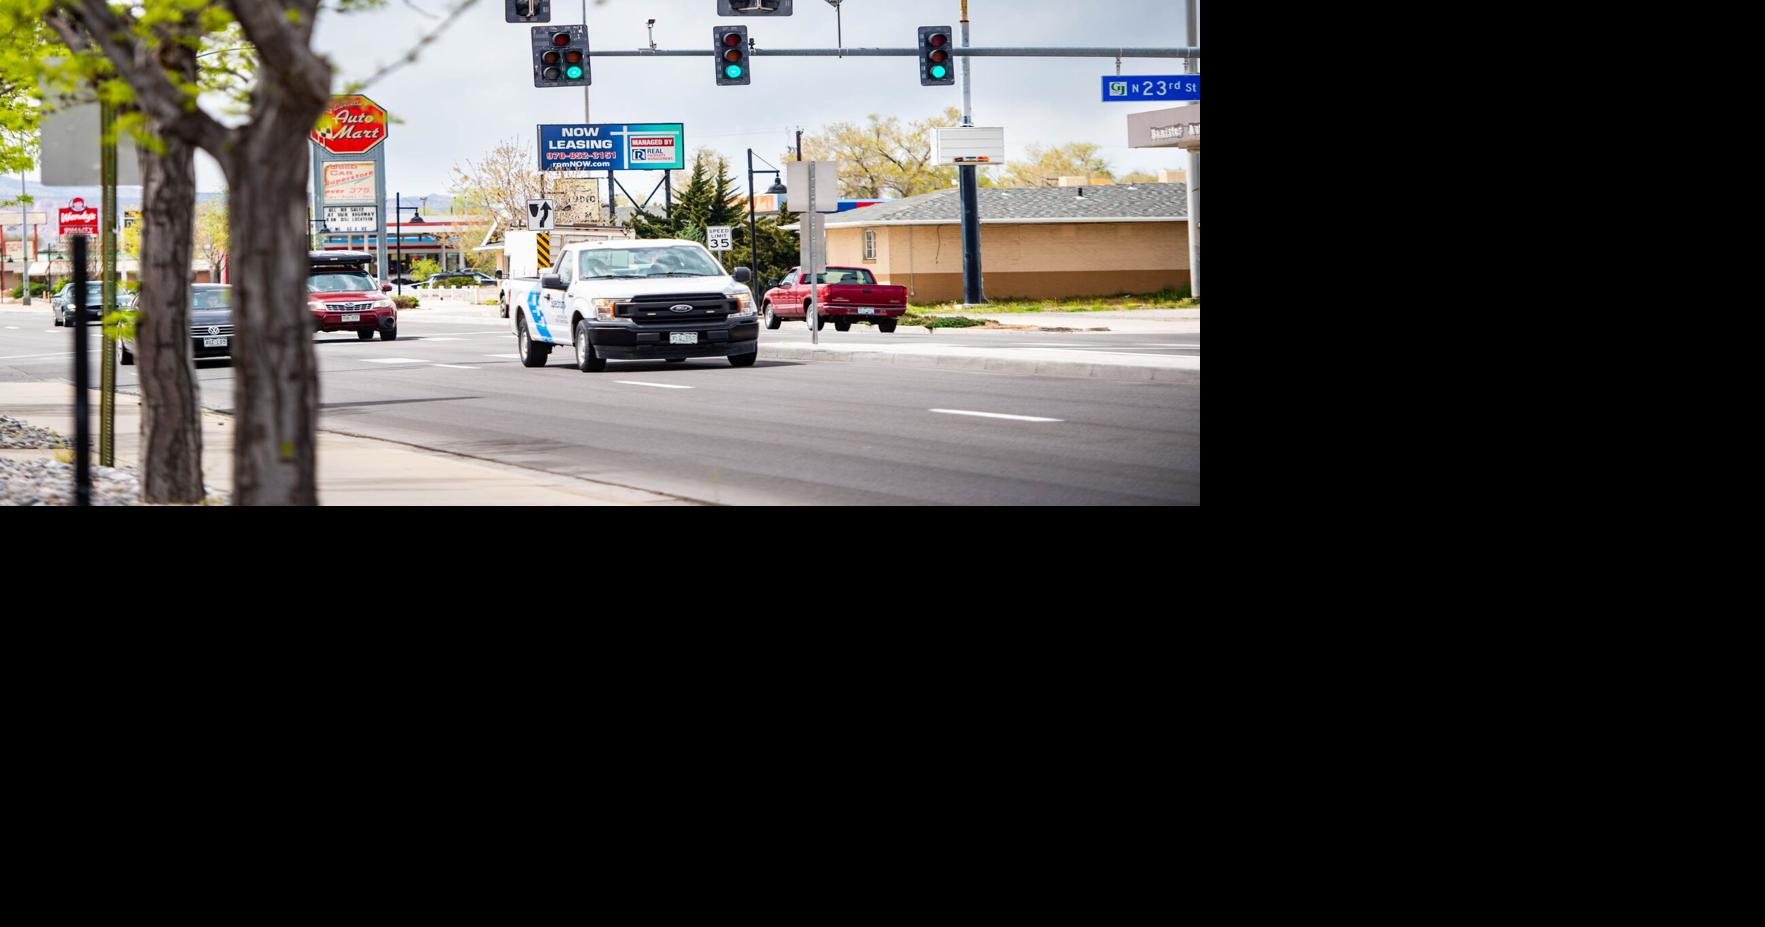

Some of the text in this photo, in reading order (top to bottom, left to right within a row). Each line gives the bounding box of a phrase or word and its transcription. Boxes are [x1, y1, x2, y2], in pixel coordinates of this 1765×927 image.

[1132, 84, 1139, 93] N
[1142, 81, 1181, 96] 23rd
[1185, 83, 1197, 92] St
[332, 110, 374, 125] Auto
[331, 125, 379, 141] Mart
[562, 127, 599, 137] NOW
[548, 139, 613, 150] LEASING
[710, 238, 730, 249] 35
